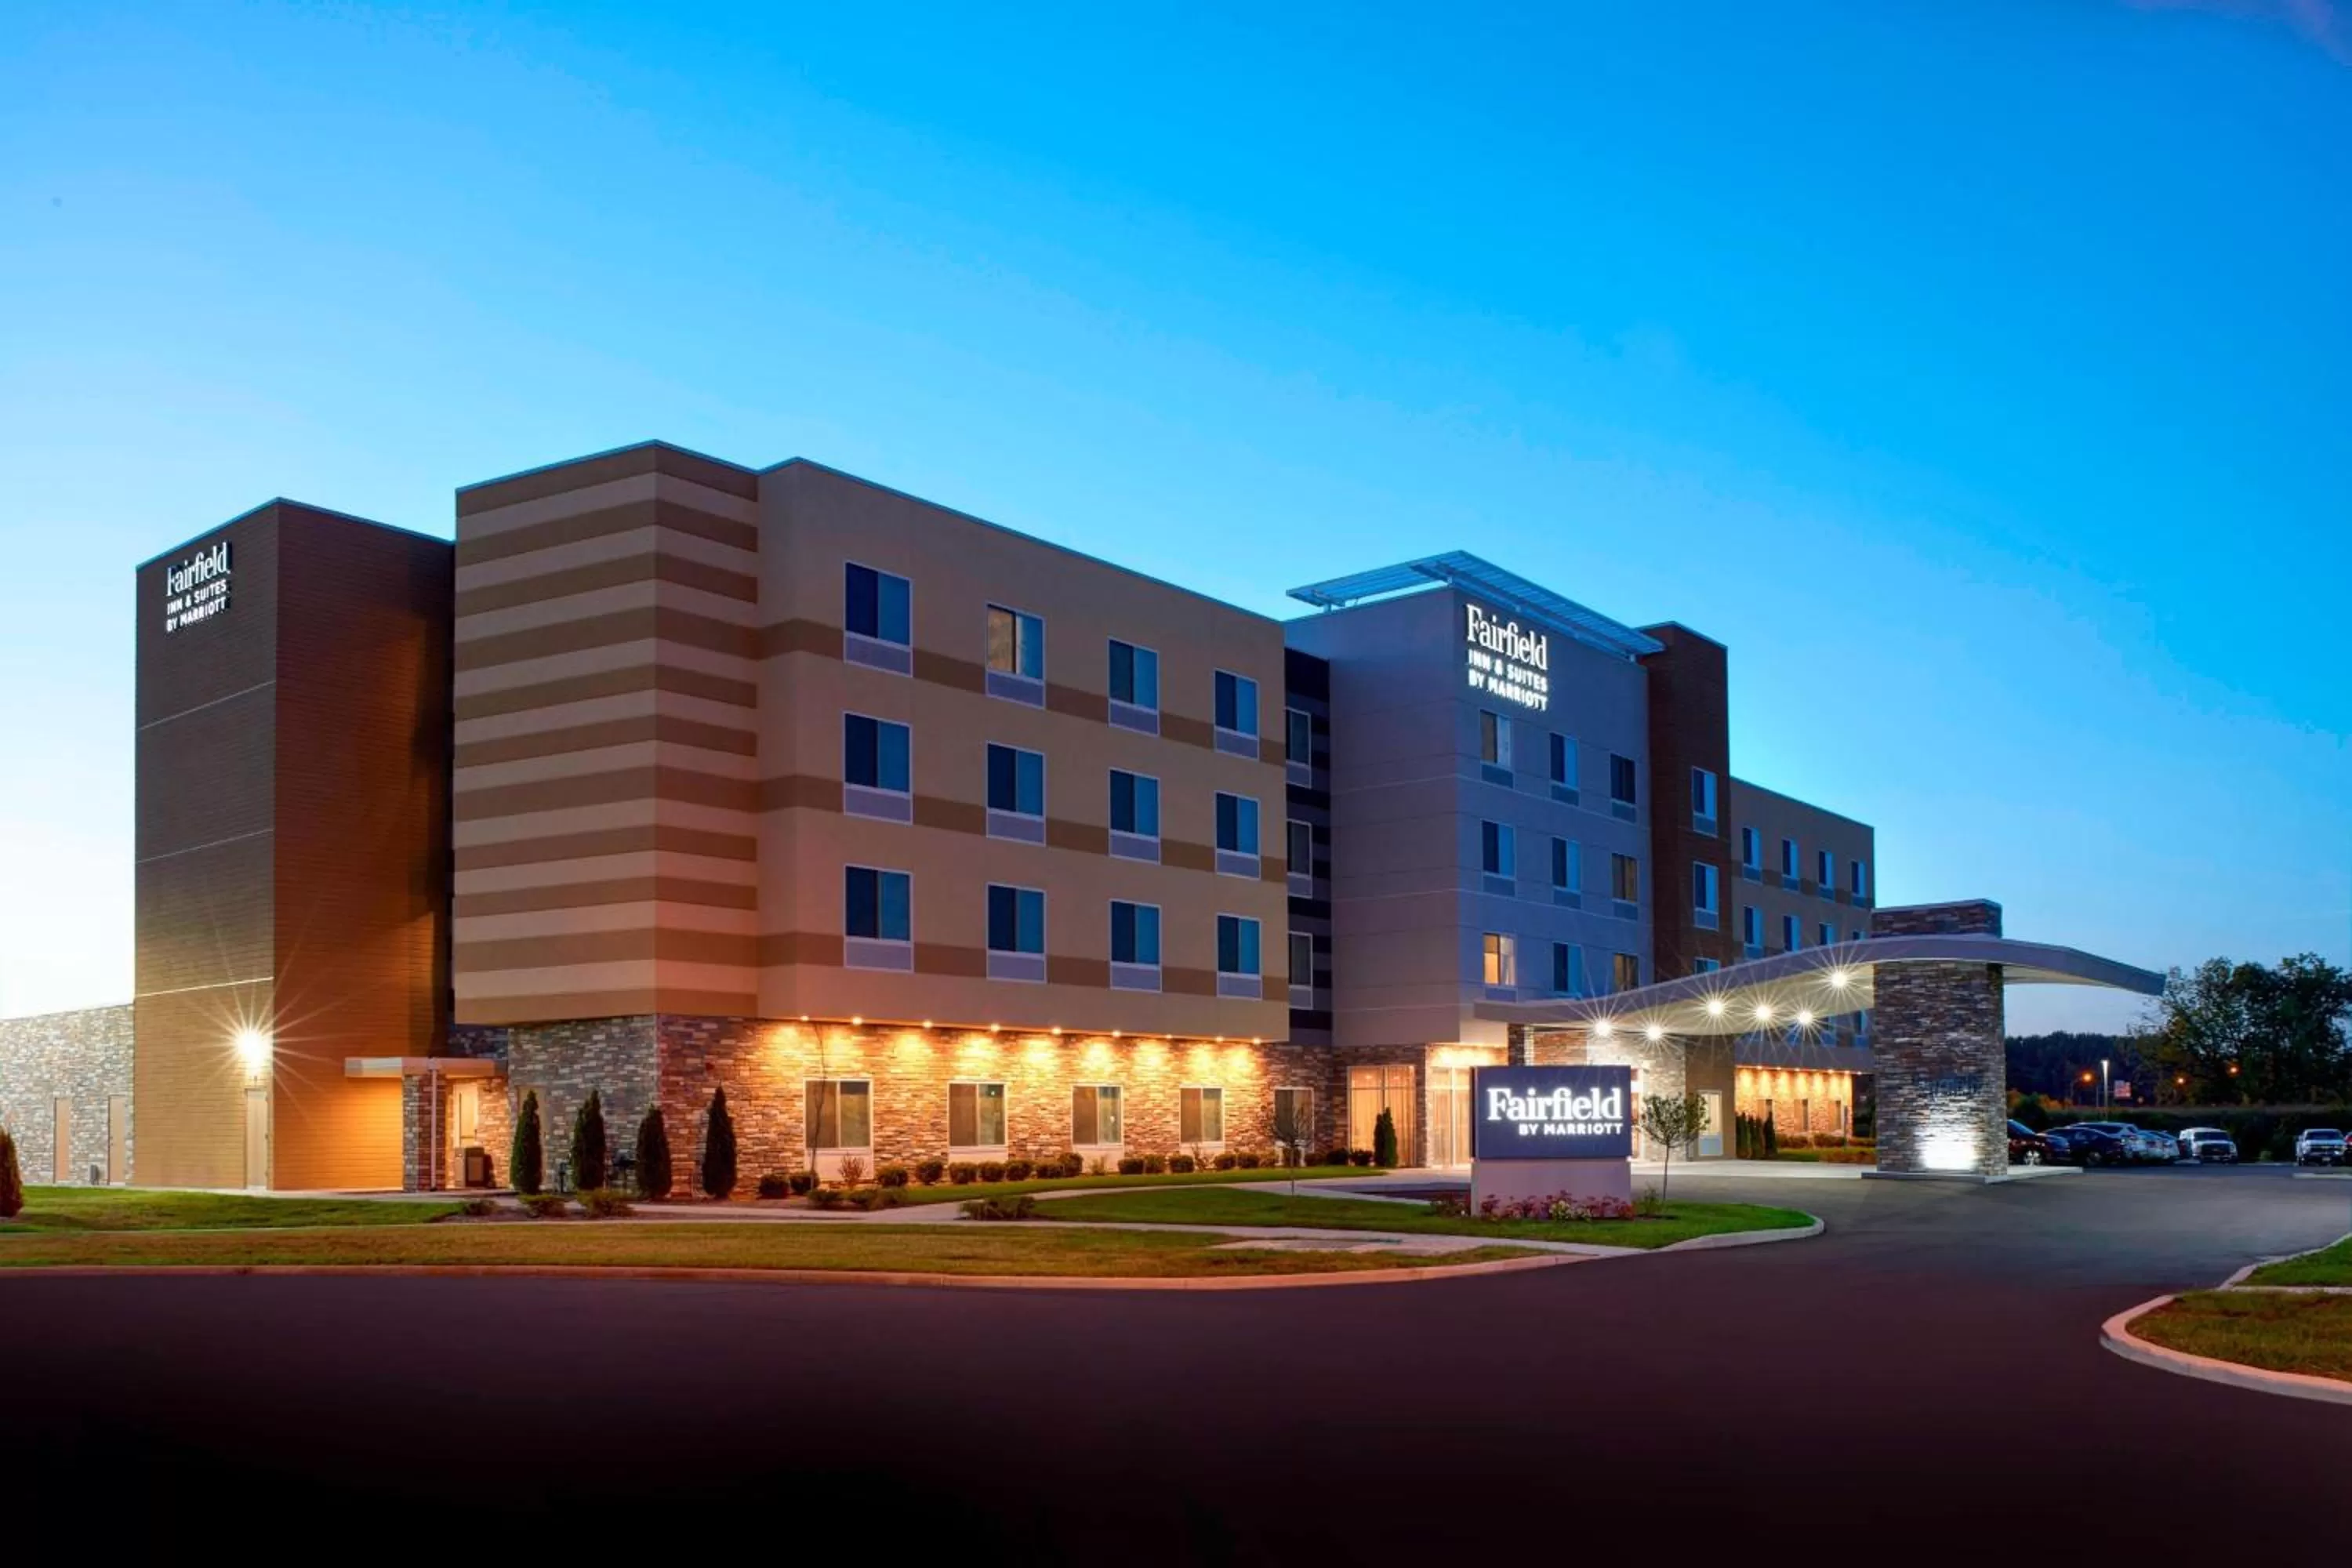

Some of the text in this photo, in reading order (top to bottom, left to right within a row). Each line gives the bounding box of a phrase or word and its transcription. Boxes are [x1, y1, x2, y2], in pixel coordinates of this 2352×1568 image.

[166, 542, 227, 597] Fairfield
[166, 596, 227, 632] BY MARRIOTT
[167, 598, 183, 615] INN
[194, 579, 227, 604] SUITES
[1466, 604, 1548, 670] Fairfield
[1468, 649, 1491, 671] INN
[1507, 664, 1548, 692] SUITES
[1468, 669, 1548, 712] BY MARRIOTT
[1486, 1087, 1624, 1121] Fairfield
[1518, 1123, 1624, 1136] BY MARRIOTT
